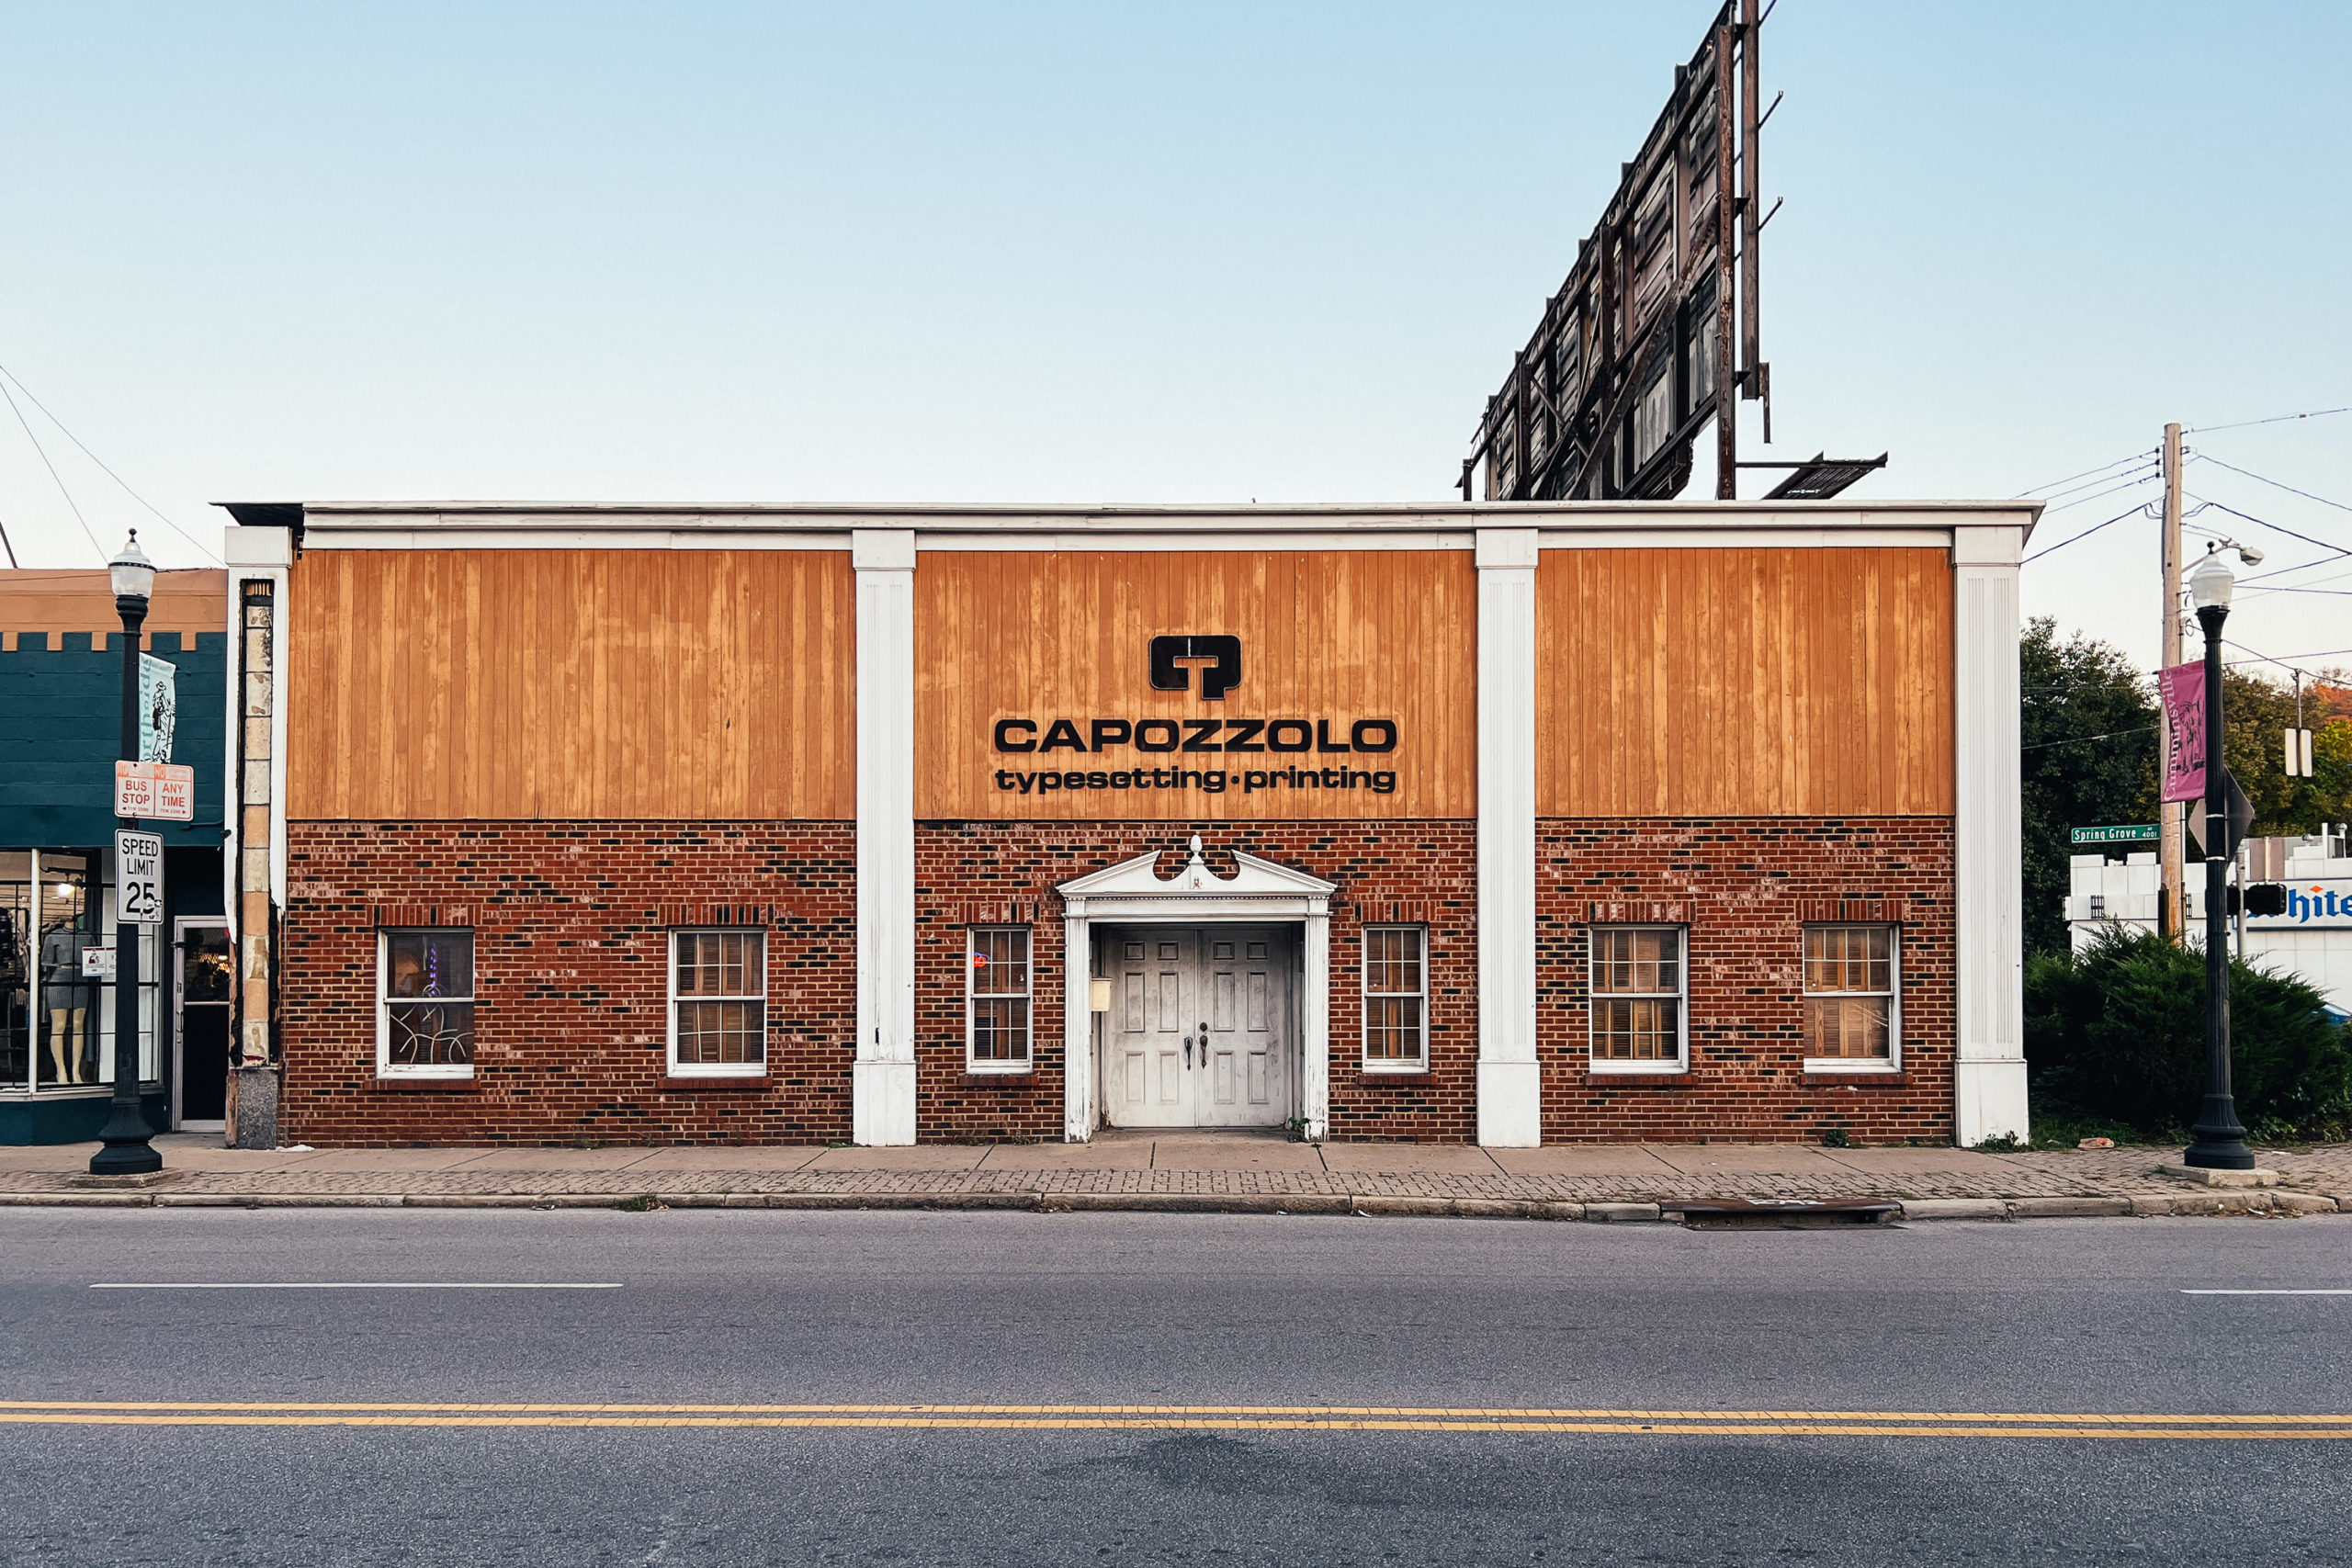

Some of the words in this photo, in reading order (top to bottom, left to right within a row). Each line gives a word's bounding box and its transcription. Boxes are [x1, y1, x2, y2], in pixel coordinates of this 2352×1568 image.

[139, 657, 154, 761] orthside
[994, 718, 1397, 753] CAPOZZOLO
[2161, 670, 2182, 802] Cumminsville
[154, 765, 166, 779] NO
[125, 780, 147, 792] BUS
[163, 783, 184, 795] ANY
[122, 793, 151, 805] STOP
[162, 795, 186, 807] TIME
[2075, 829, 2105, 841] Spring
[2109, 828, 2136, 839] Grove
[122, 838, 159, 857] SPEED
[127, 857, 155, 876] LIMIT
[126, 881, 155, 914] 25
[2247, 886, 2352, 924] hite
